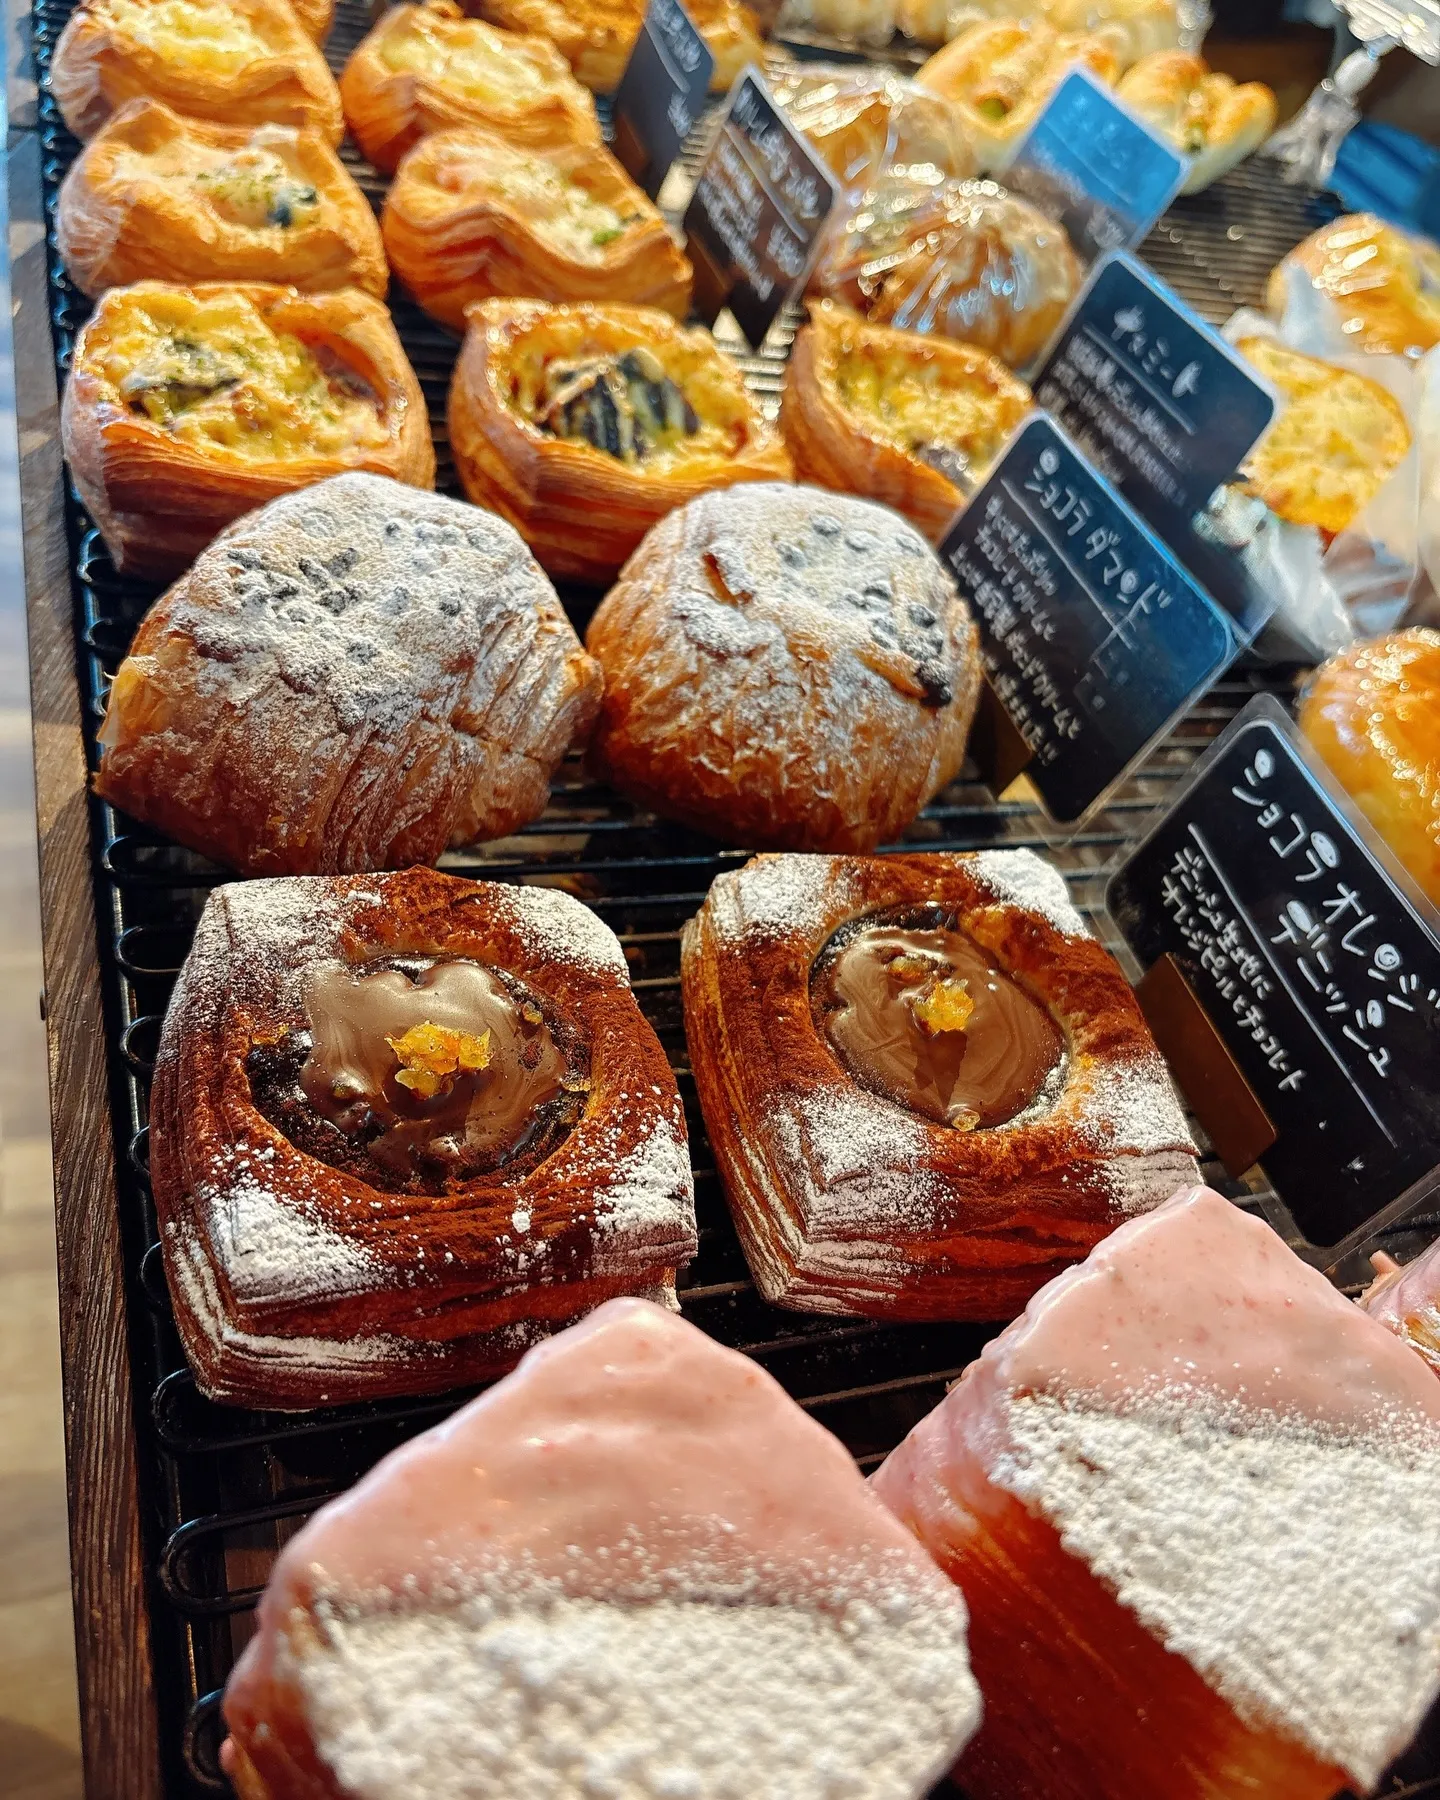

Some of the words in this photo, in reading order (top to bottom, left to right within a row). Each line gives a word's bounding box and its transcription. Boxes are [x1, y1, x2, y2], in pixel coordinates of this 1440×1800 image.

[1161, 875, 1307, 1092] オレンジピールとチョコレート
[1173, 845, 1274, 1000] デニッシュ生地に
[1270, 899, 1391, 1079] デニッシュ
